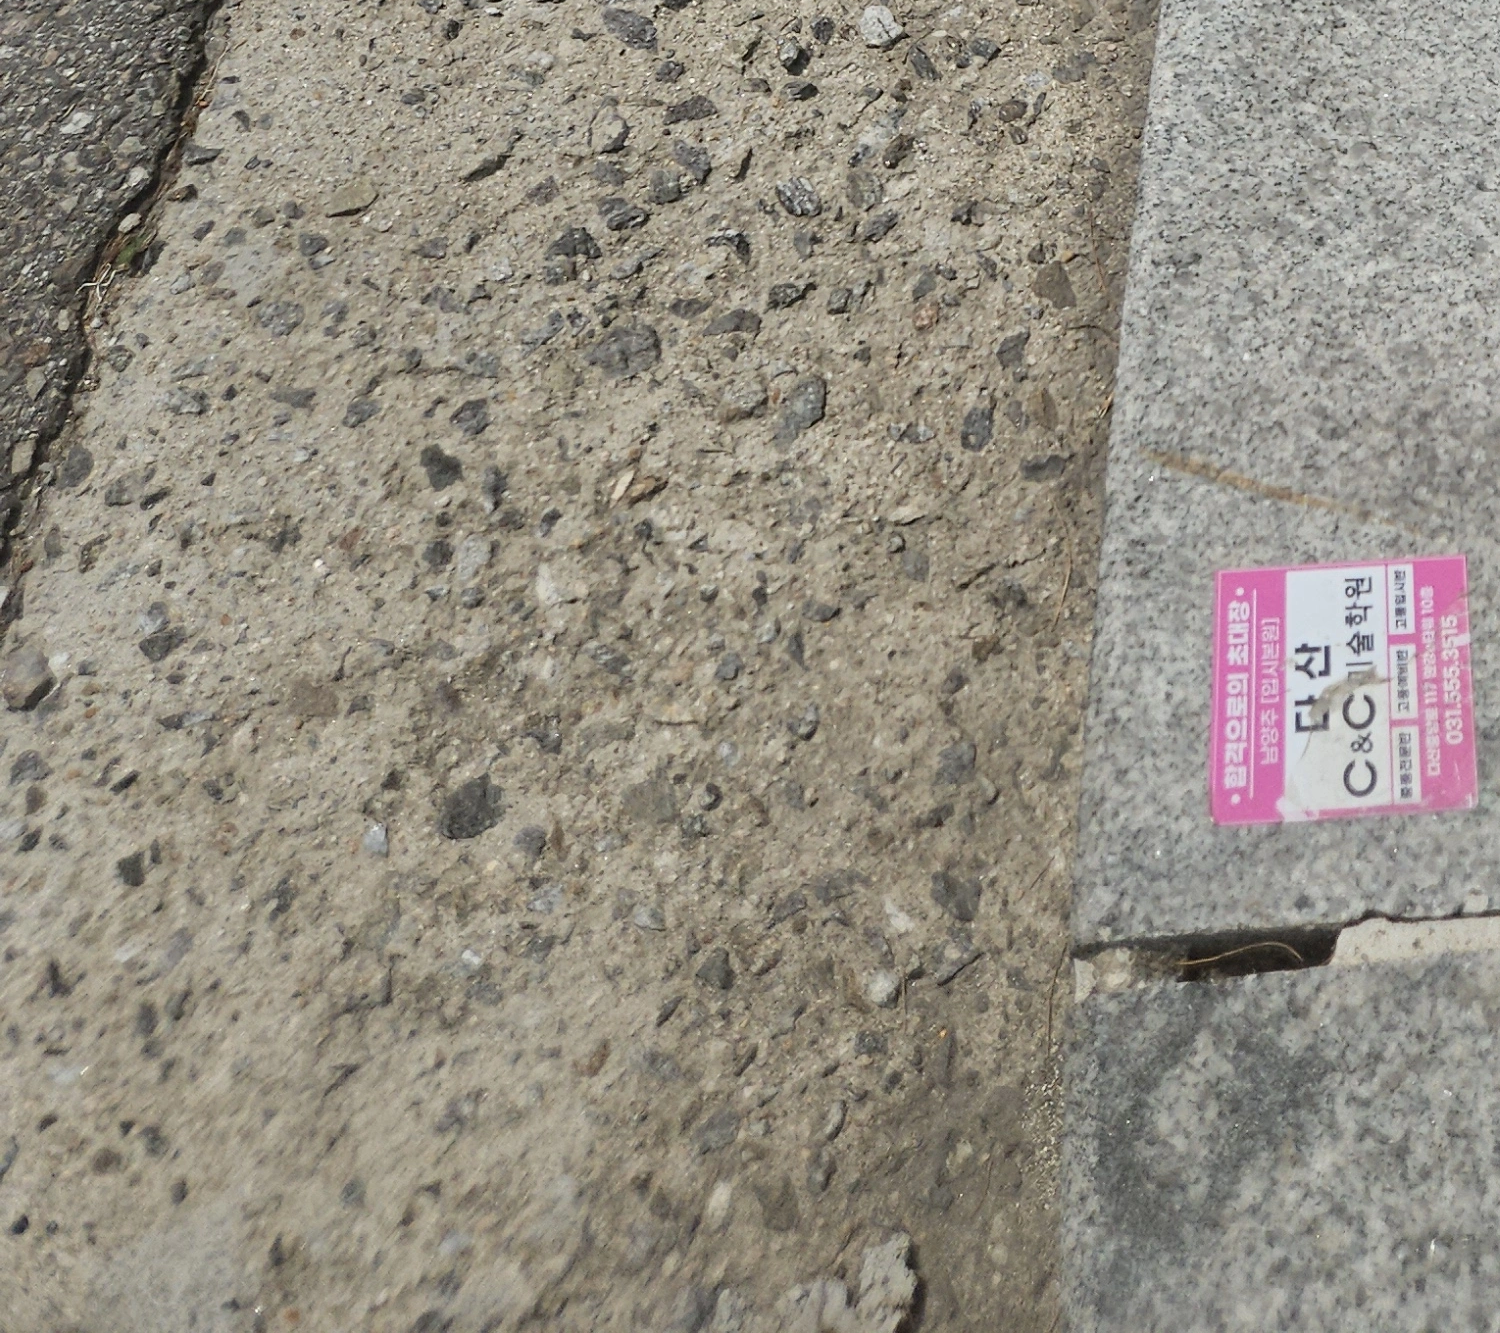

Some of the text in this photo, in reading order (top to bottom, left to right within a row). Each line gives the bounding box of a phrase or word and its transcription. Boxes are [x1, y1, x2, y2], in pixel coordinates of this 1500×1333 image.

[1393, 569, 1407, 630] 고등입시반
[1224, 599, 1251, 790] 합격으로의 초대장
[1440, 614, 1463, 745] 031.555.3515
[1260, 708, 1280, 765] 남양주
